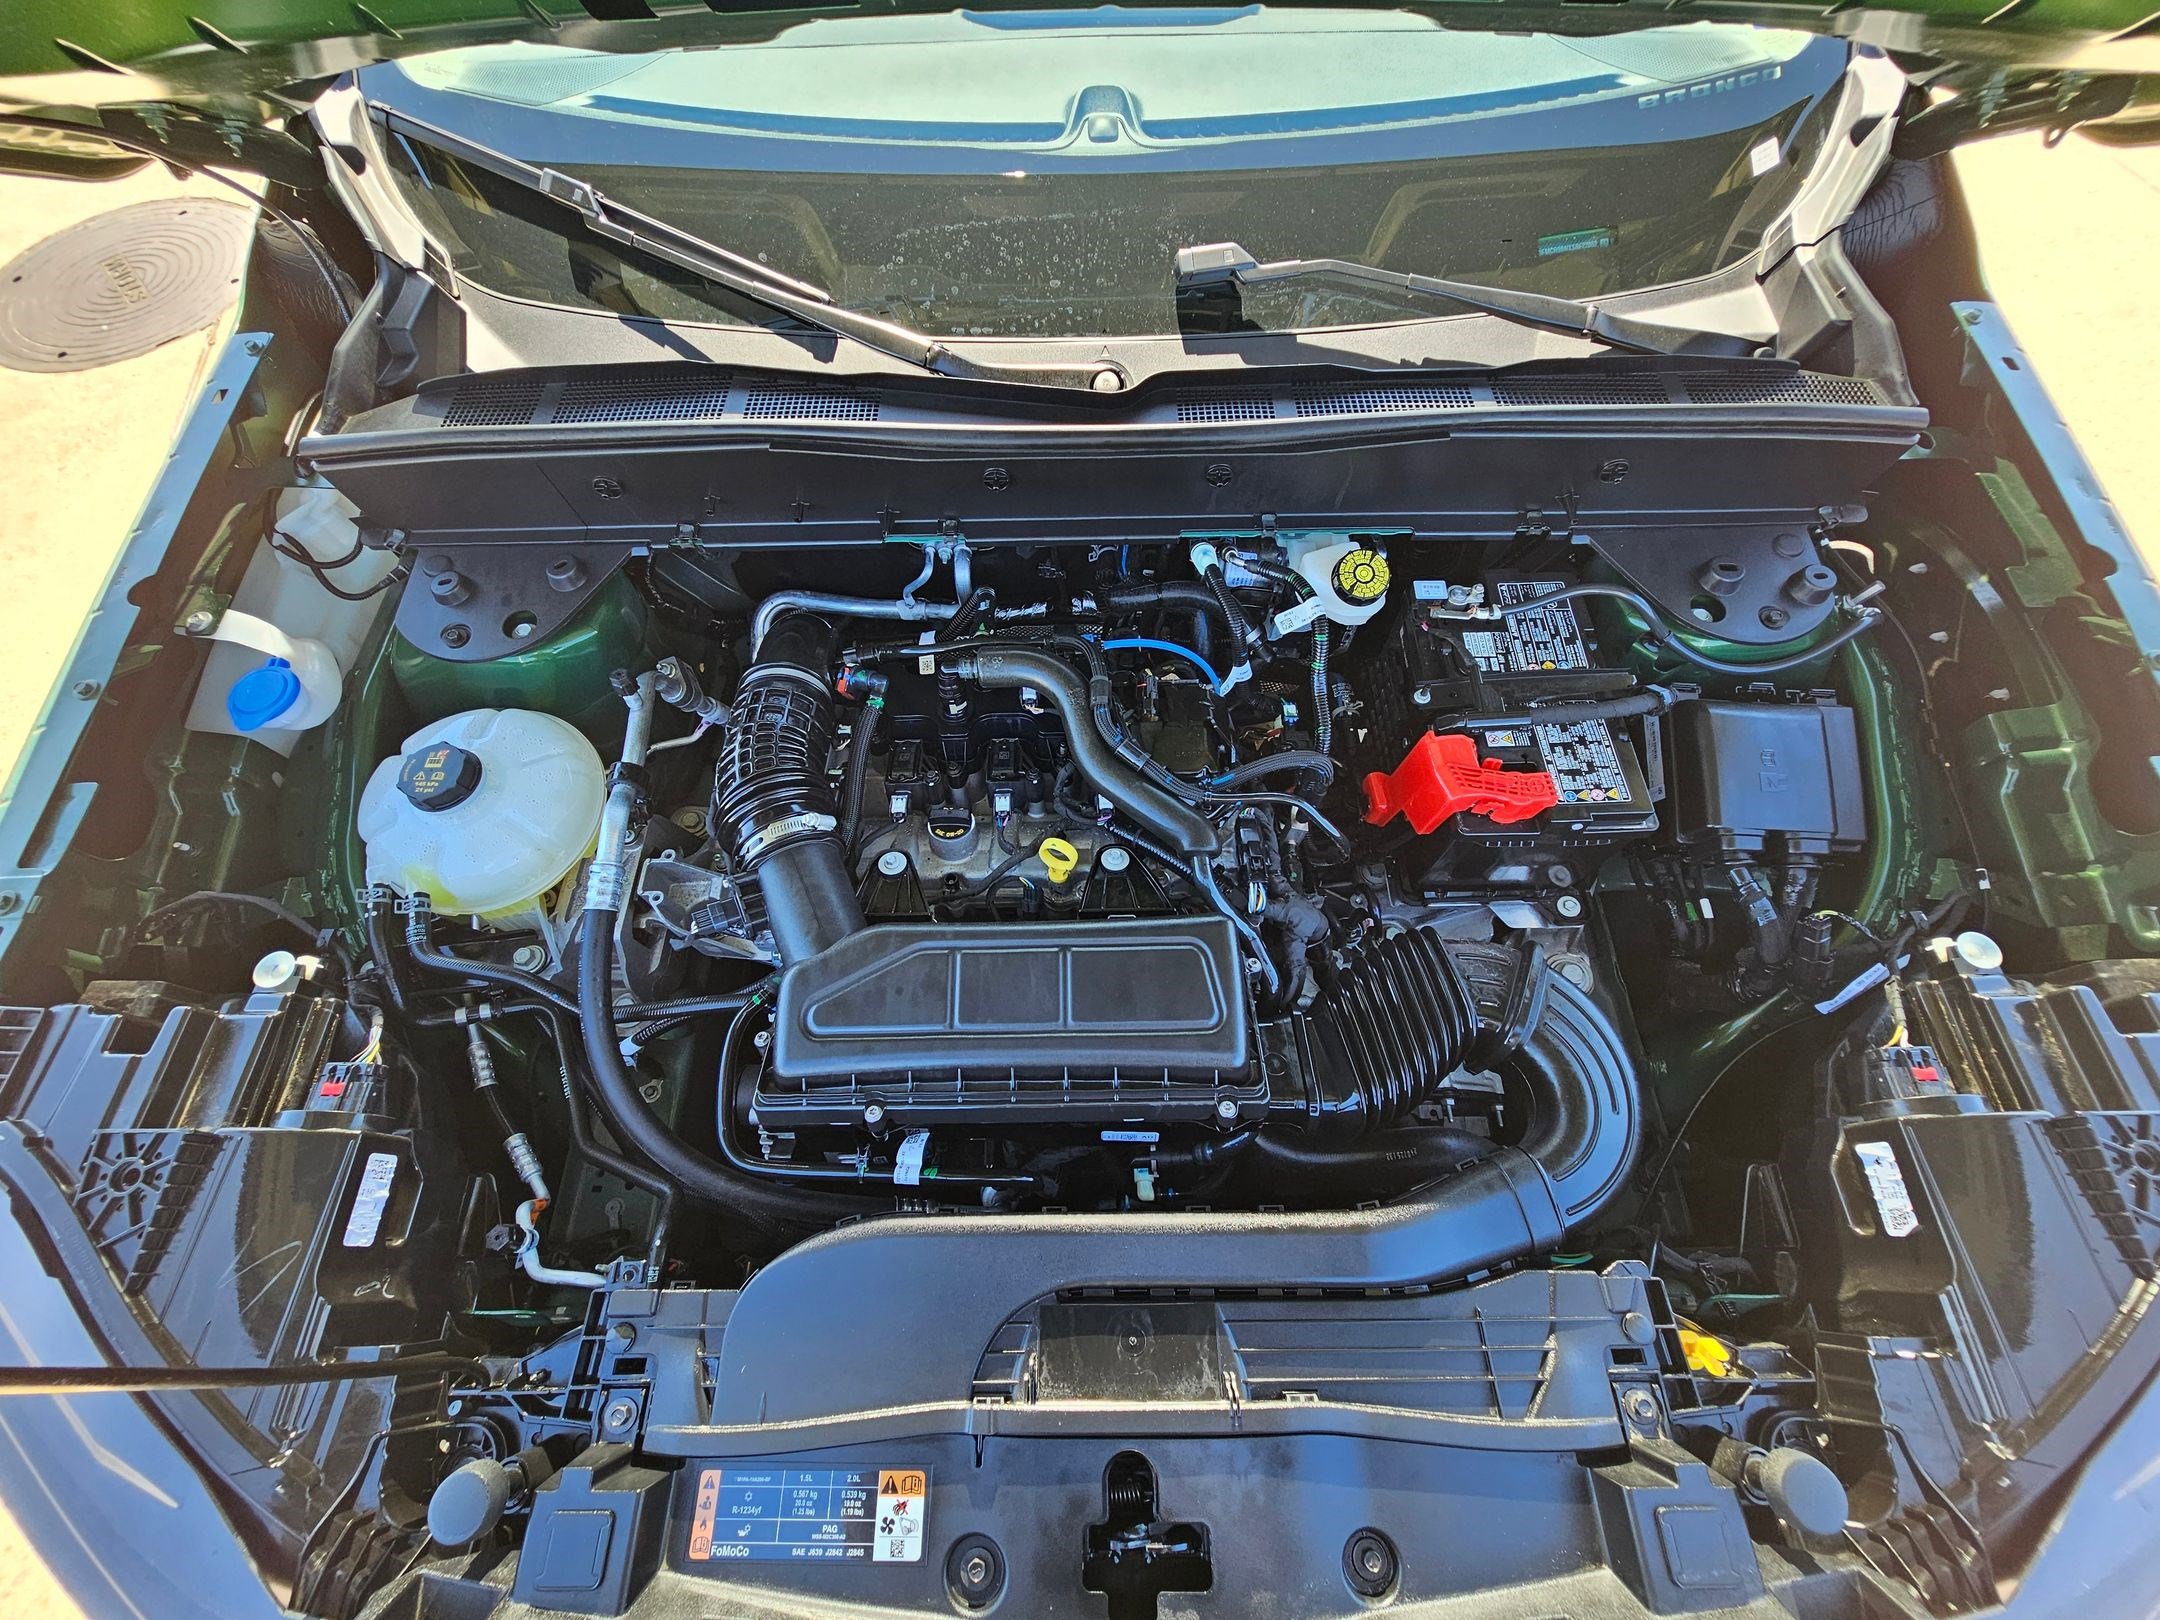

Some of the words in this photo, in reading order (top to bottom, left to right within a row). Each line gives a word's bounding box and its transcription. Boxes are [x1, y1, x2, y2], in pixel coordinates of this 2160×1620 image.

[1637, 66, 1782, 110] BRONCO
[103, 258, 149, 304] STORM
[800, 1474, 813, 1482] 1.5L
[793, 1490, 808, 1498] 0.567
[810, 1490, 818, 1500] kg
[858, 1491, 867, 1501] kg
[822, 1525, 838, 1533] PAG
[710, 1545, 750, 1557] FoMoCo
[792, 1548, 806, 1556] SAE
[808, 1548, 823, 1556] J639
[825, 1548, 843, 1557] J2842
